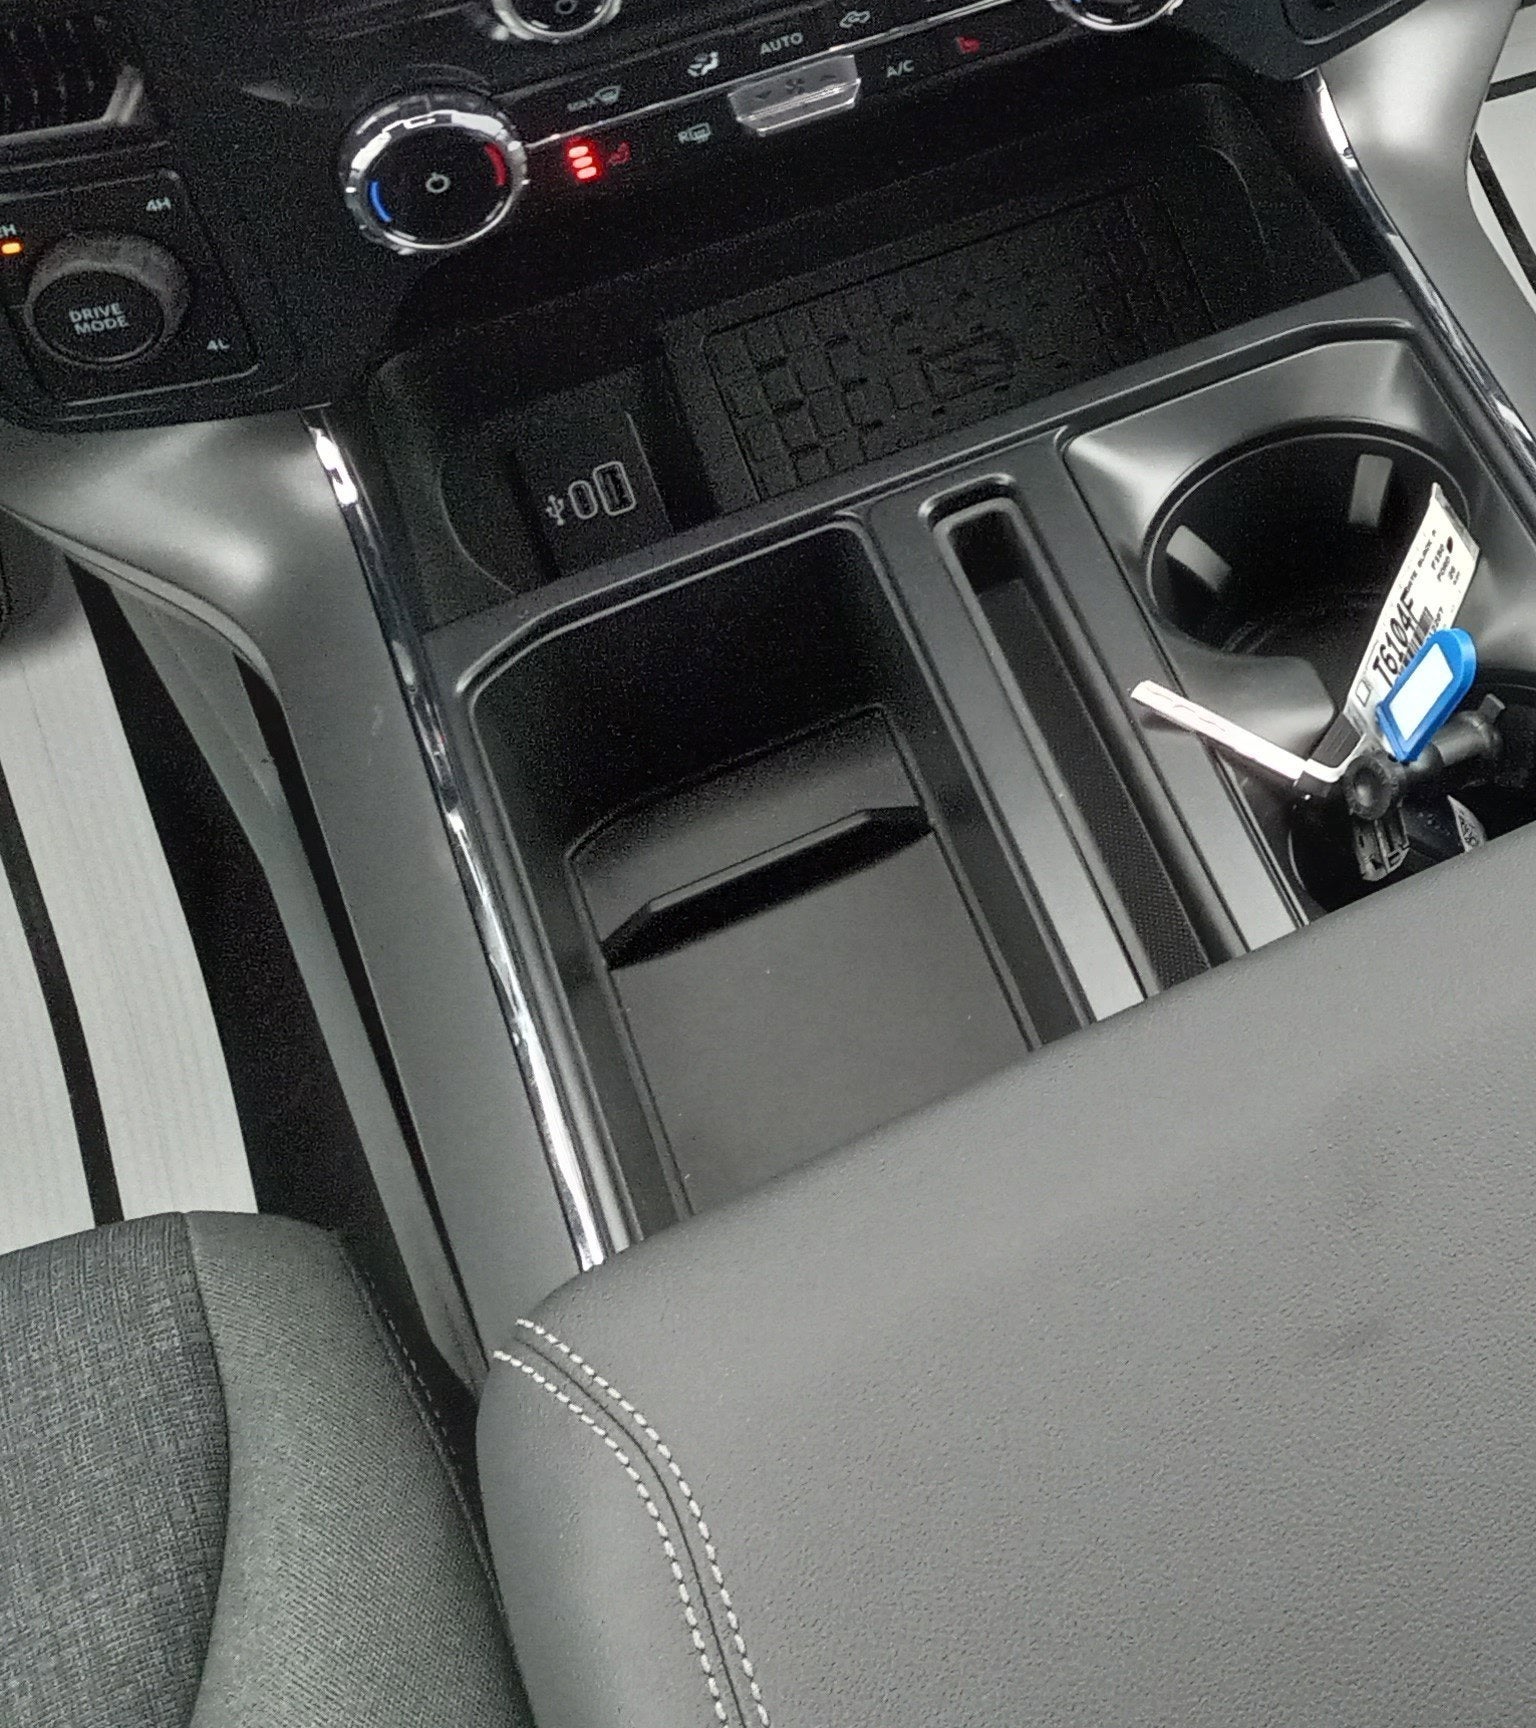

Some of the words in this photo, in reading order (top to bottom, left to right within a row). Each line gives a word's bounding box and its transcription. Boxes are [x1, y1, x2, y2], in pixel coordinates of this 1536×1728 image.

[759, 32, 804, 55] AUTO
[885, 58, 916, 79] A/C
[145, 196, 173, 213] 4H
[68, 301, 124, 325] DRIVE
[73, 315, 130, 336] MODE
[206, 337, 231, 352] 4L
